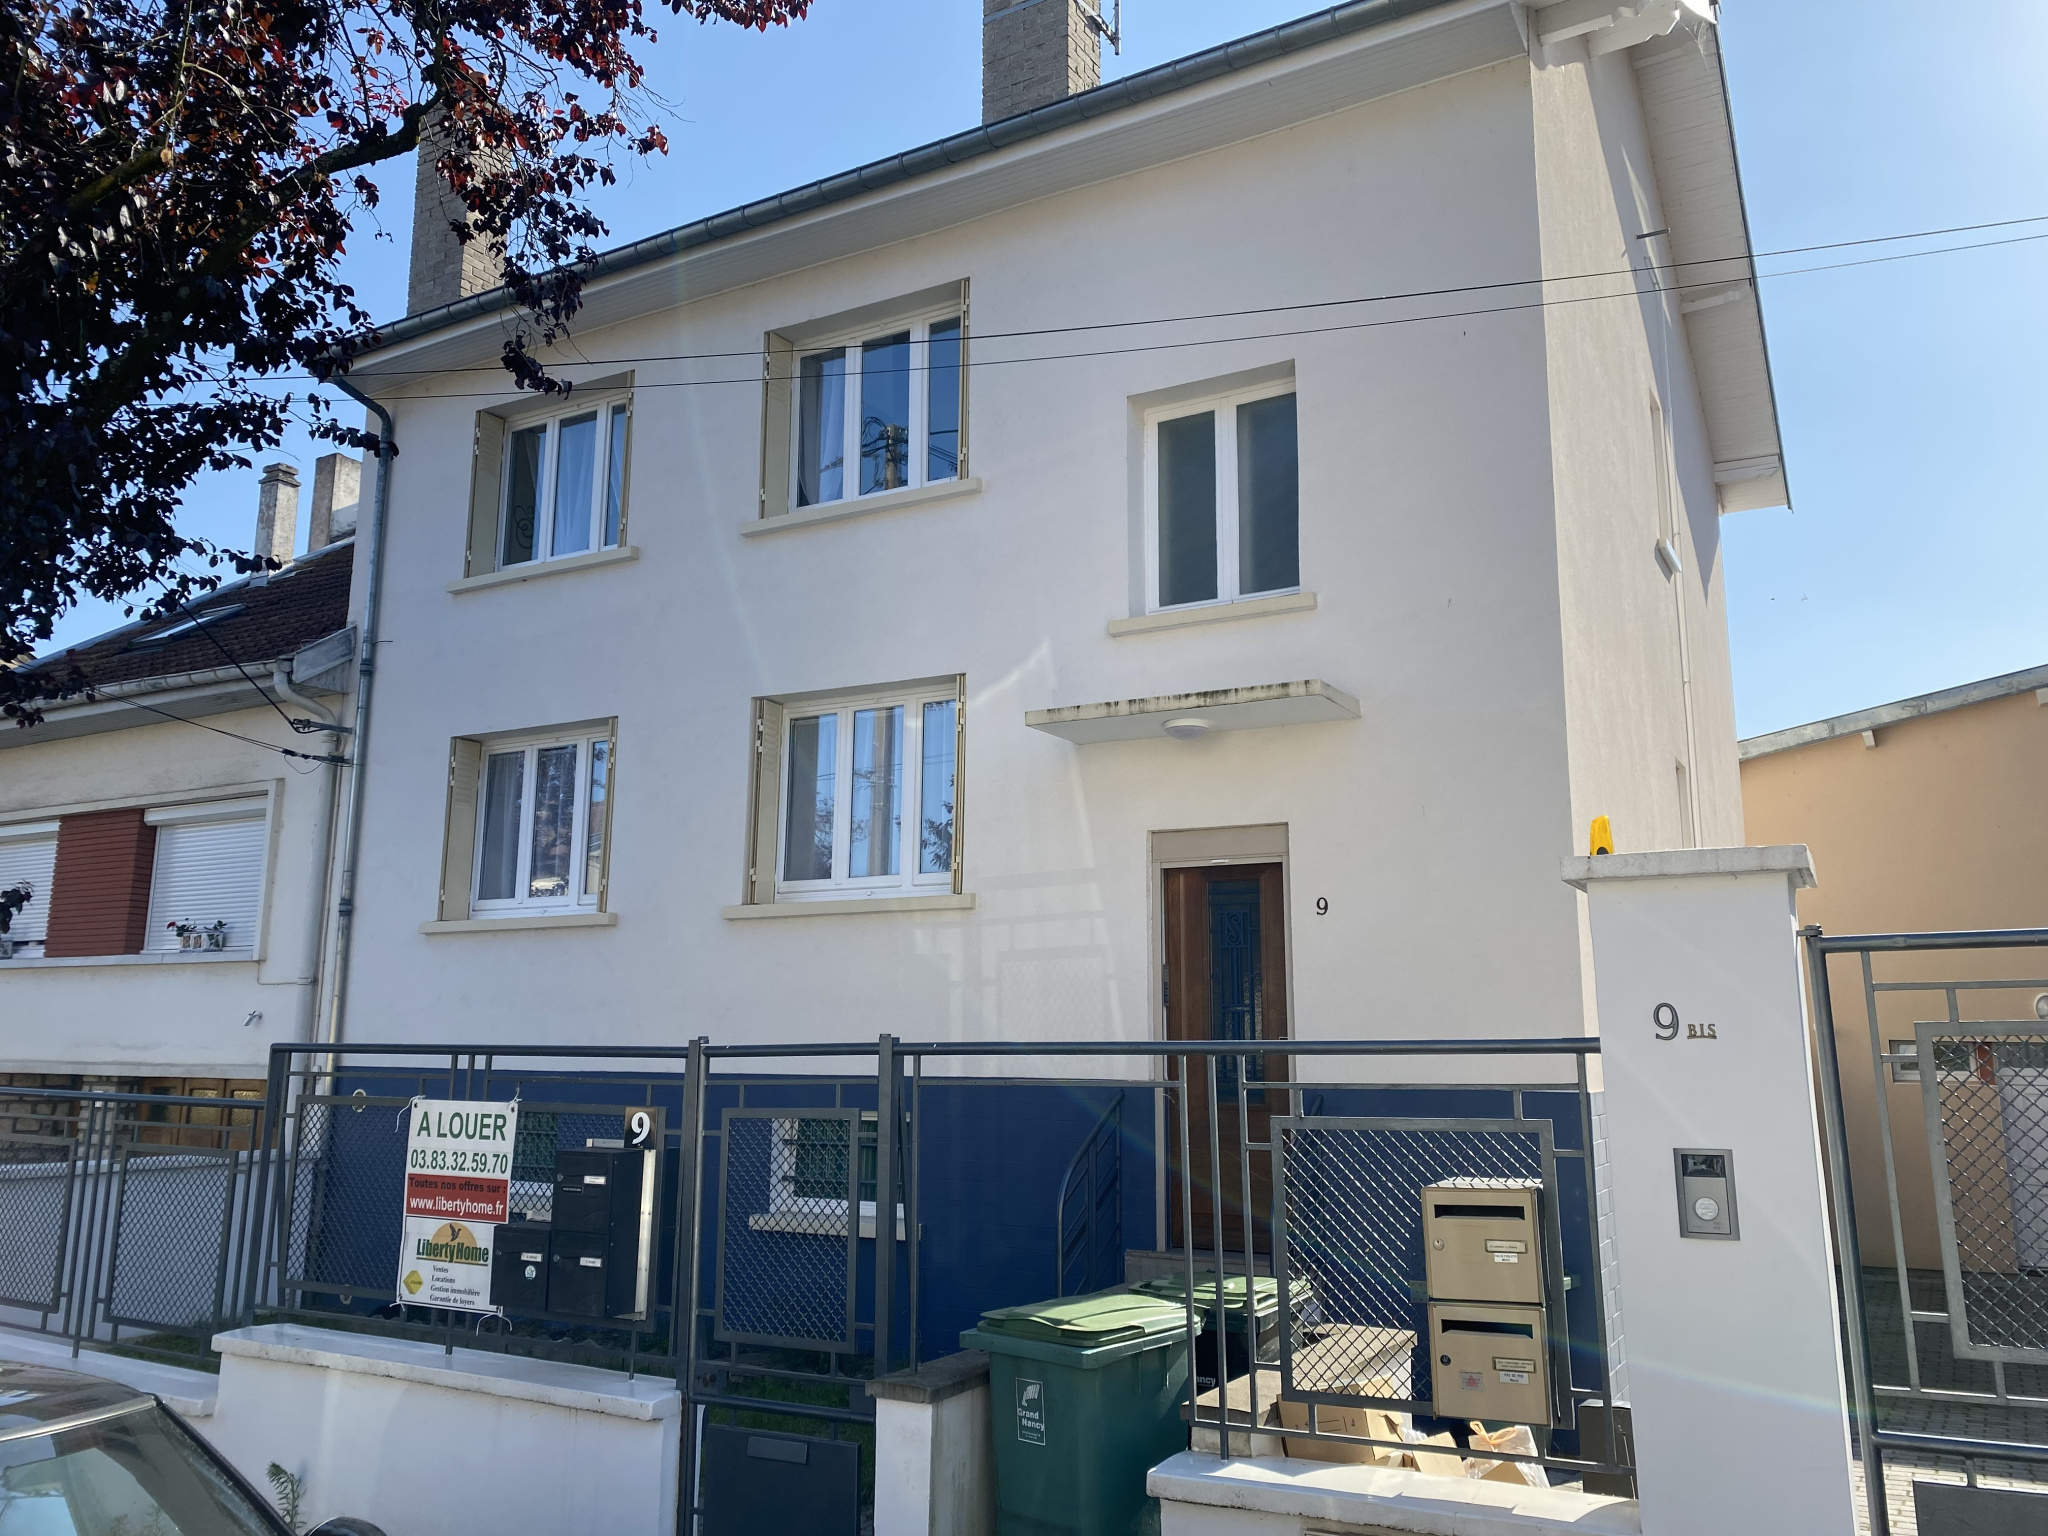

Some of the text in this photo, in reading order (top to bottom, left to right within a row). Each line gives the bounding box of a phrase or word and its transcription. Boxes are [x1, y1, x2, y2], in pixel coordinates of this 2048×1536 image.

[1316, 896, 1329, 916] 9
[1653, 1002, 1717, 1041] 9 BIS
[416, 1111, 507, 1141] A LOUER
[631, 1111, 650, 1145] 9
[410, 1148, 508, 1175] 03.83.32.59.70
[408, 1176, 438, 1189] Toutes
[440, 1181, 457, 1190] nos
[458, 1180, 484, 1193] offres
[486, 1184, 502, 1194] sur
[409, 1195, 504, 1216] www.libertyhome.fr
[432, 1264, 449, 1274] Ventes
[431, 1274, 456, 1284] Locations
[430, 1284, 450, 1293] Gestion
[429, 1293, 475, 1307] Garantie de loyers
[1017, 1408, 1040, 1420] Grand
[1021, 1418, 1045, 1432] Nancy
